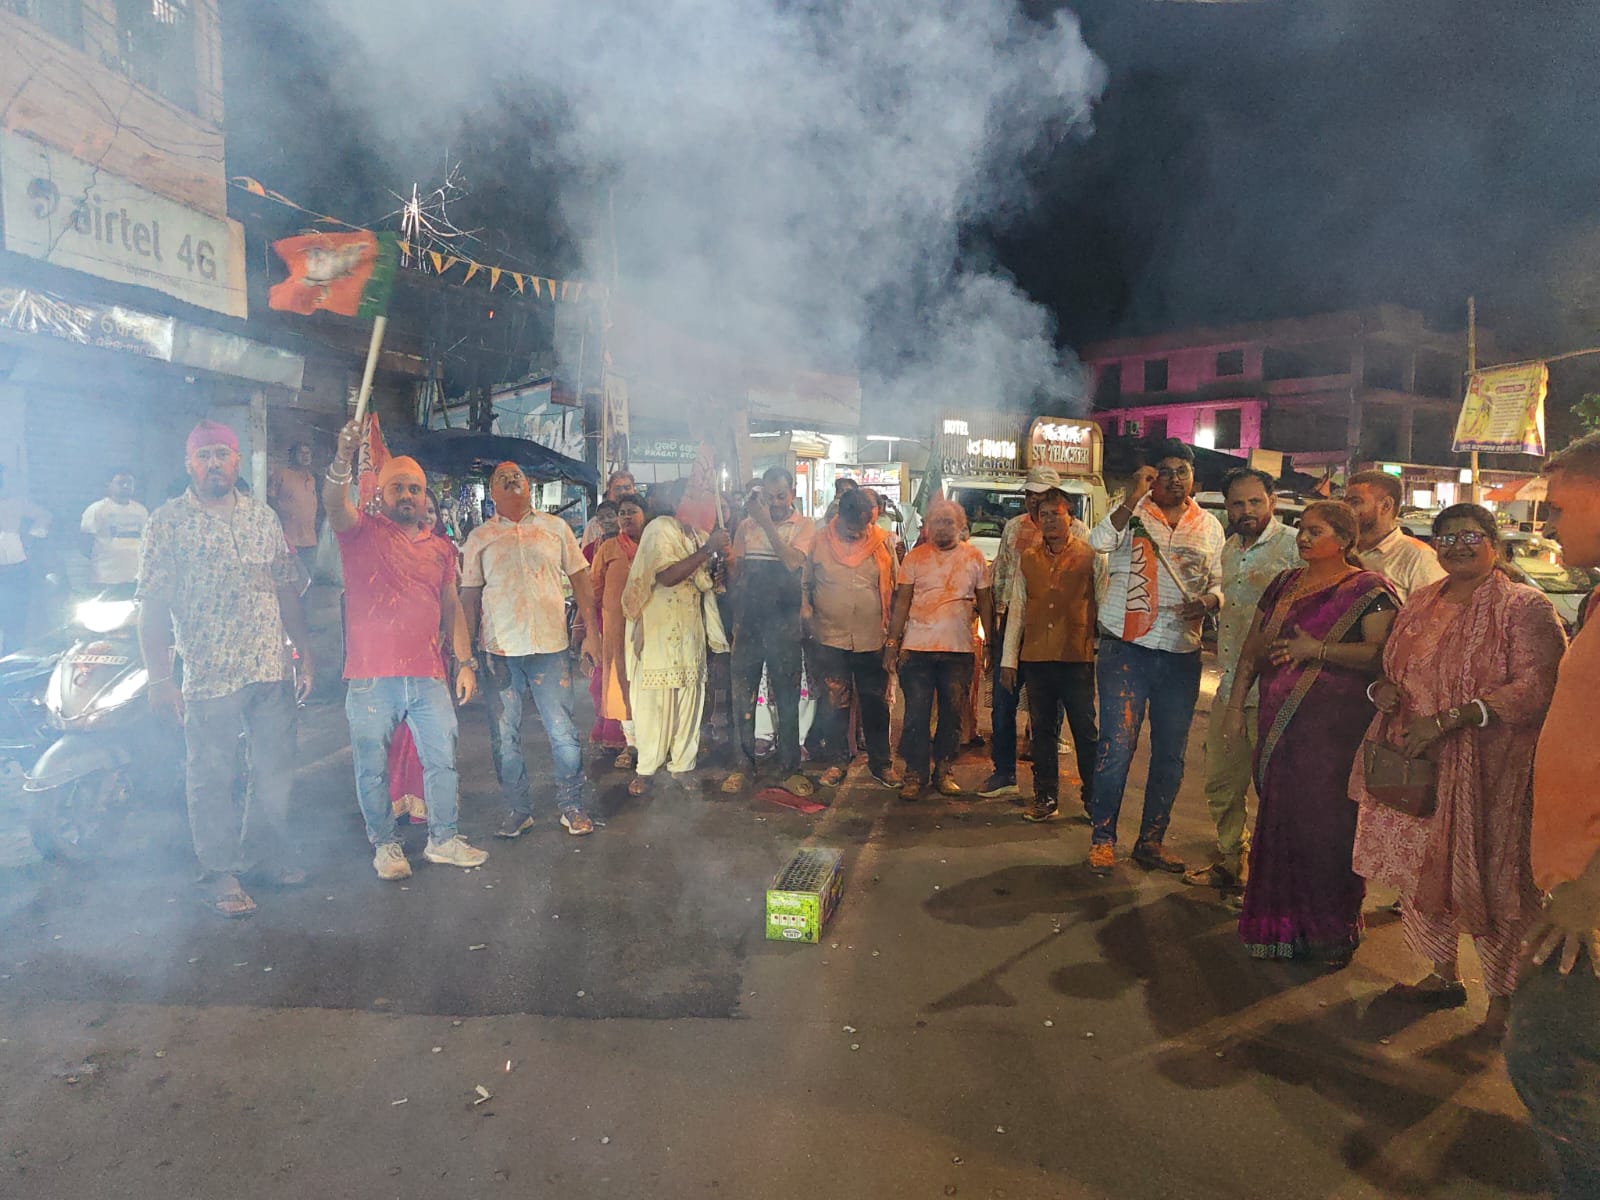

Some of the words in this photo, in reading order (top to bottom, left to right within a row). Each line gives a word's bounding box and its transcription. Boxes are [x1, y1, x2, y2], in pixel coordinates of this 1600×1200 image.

[74, 196, 164, 263] airtel
[177, 234, 217, 281] 4G
[944, 420, 969, 435] HOTEL
[680, 452, 697, 460] STO
